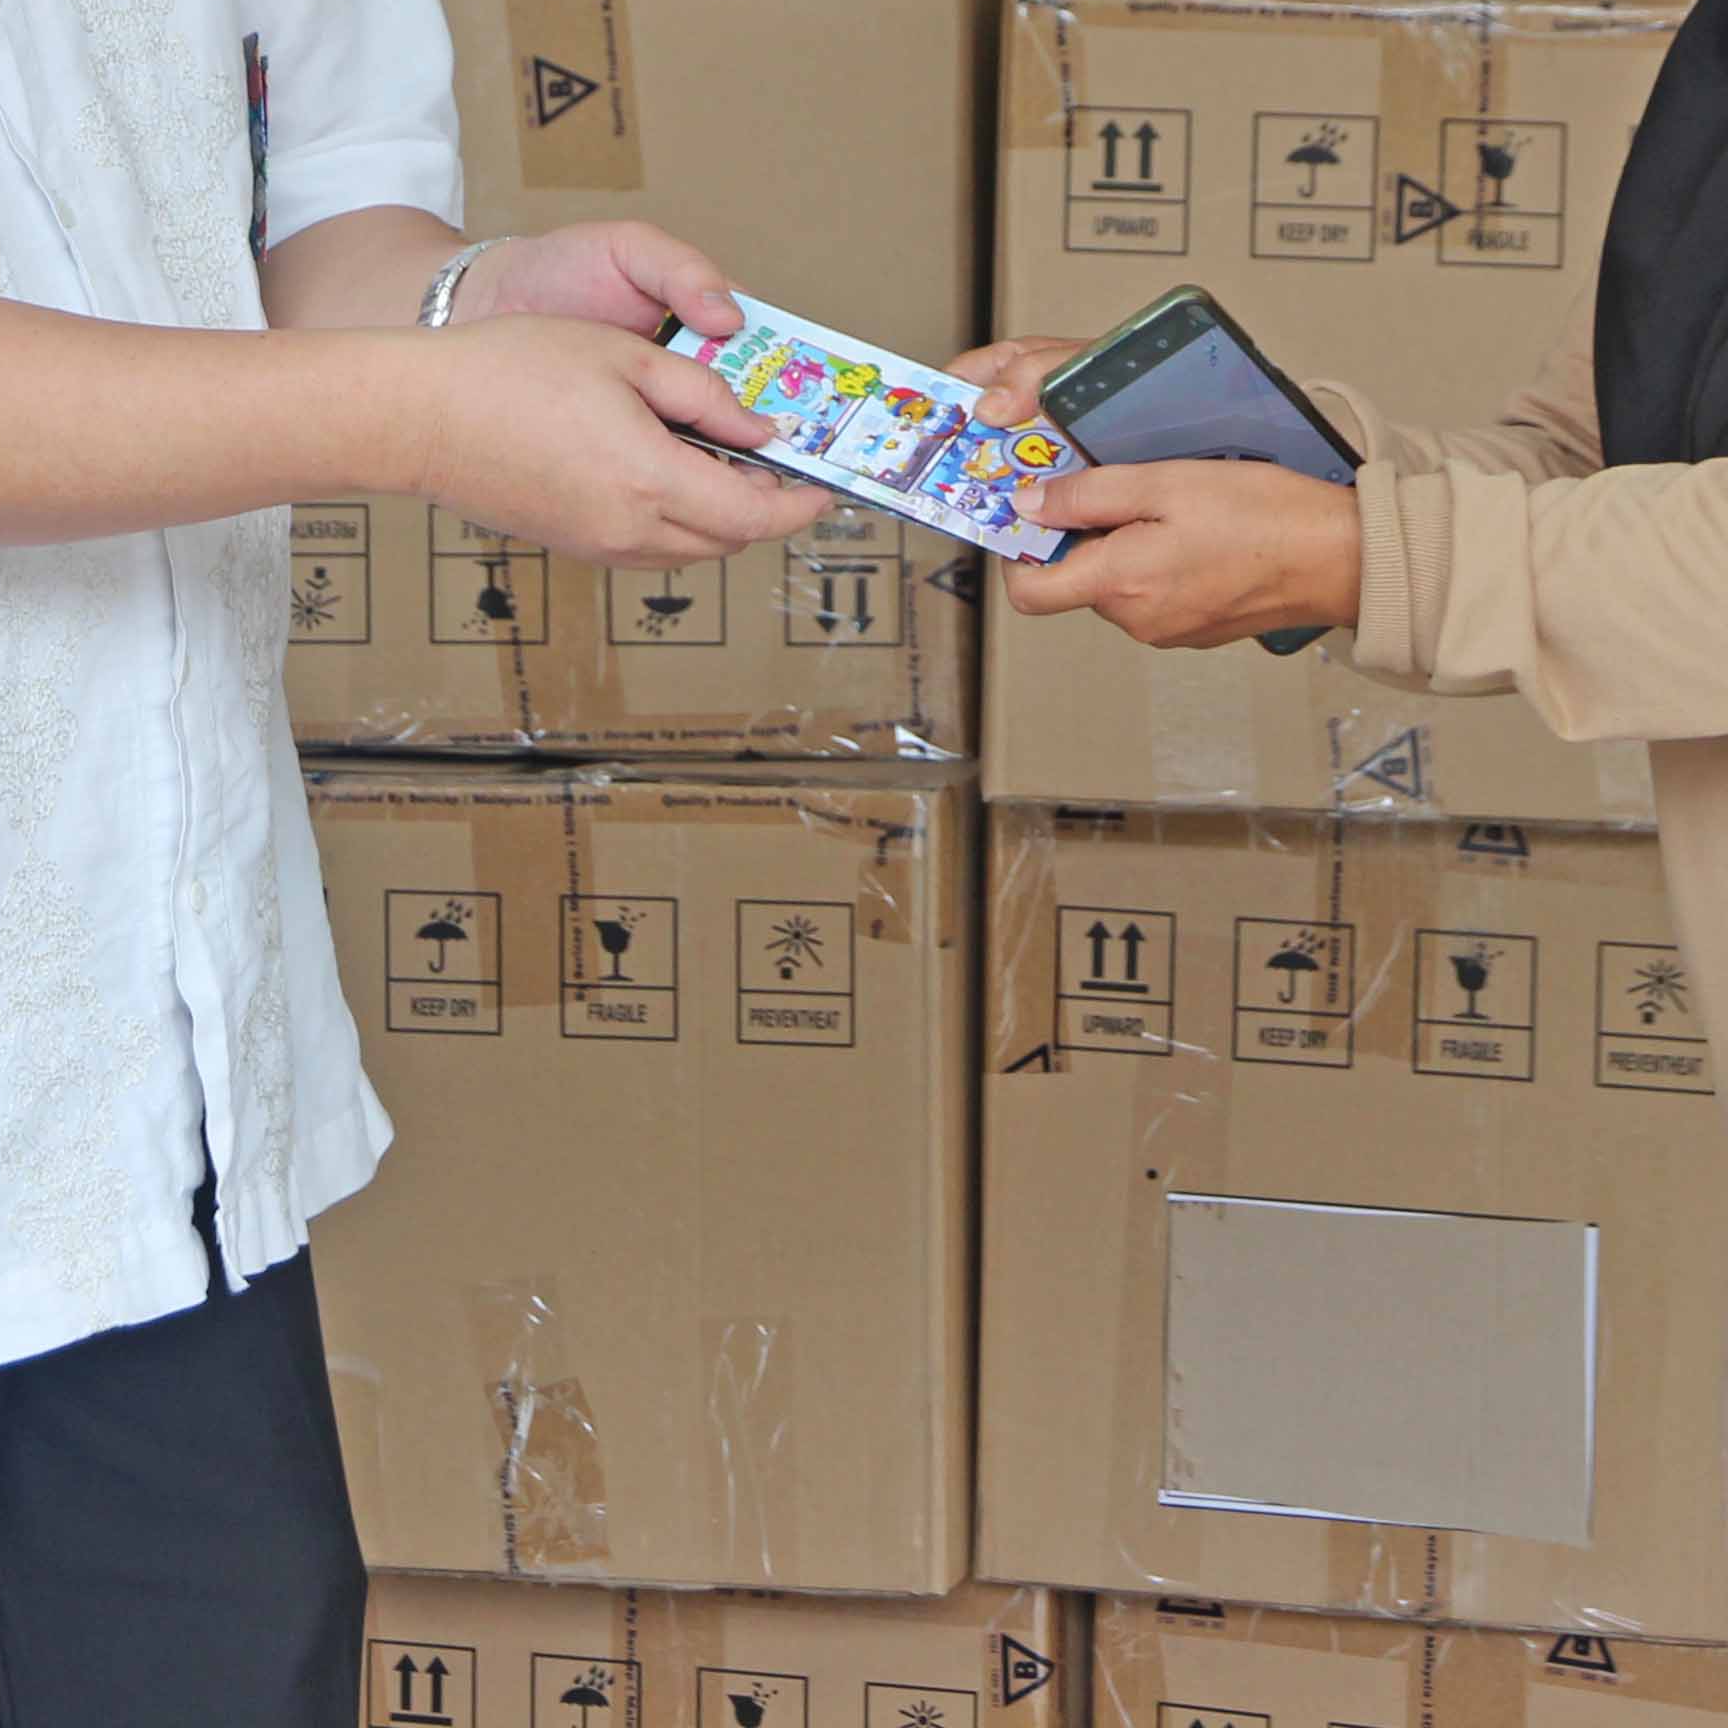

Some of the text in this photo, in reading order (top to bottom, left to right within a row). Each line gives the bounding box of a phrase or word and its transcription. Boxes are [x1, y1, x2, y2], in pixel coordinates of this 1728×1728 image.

[1093, 215, 1161, 238] UPWARD
[1277, 223, 1349, 244] KEEP DRY
[410, 995, 478, 1018] KEEP DRY
[587, 1002, 649, 1024] FRAGILE
[747, 1007, 842, 1031] PREVENTHEAT
[1082, 1014, 1145, 1038] UPWARD
[1258, 1026, 1329, 1049] KEEP DRY
[1440, 1039, 1504, 1063] FRAGILE
[1013, 1661, 1038, 1679] B
